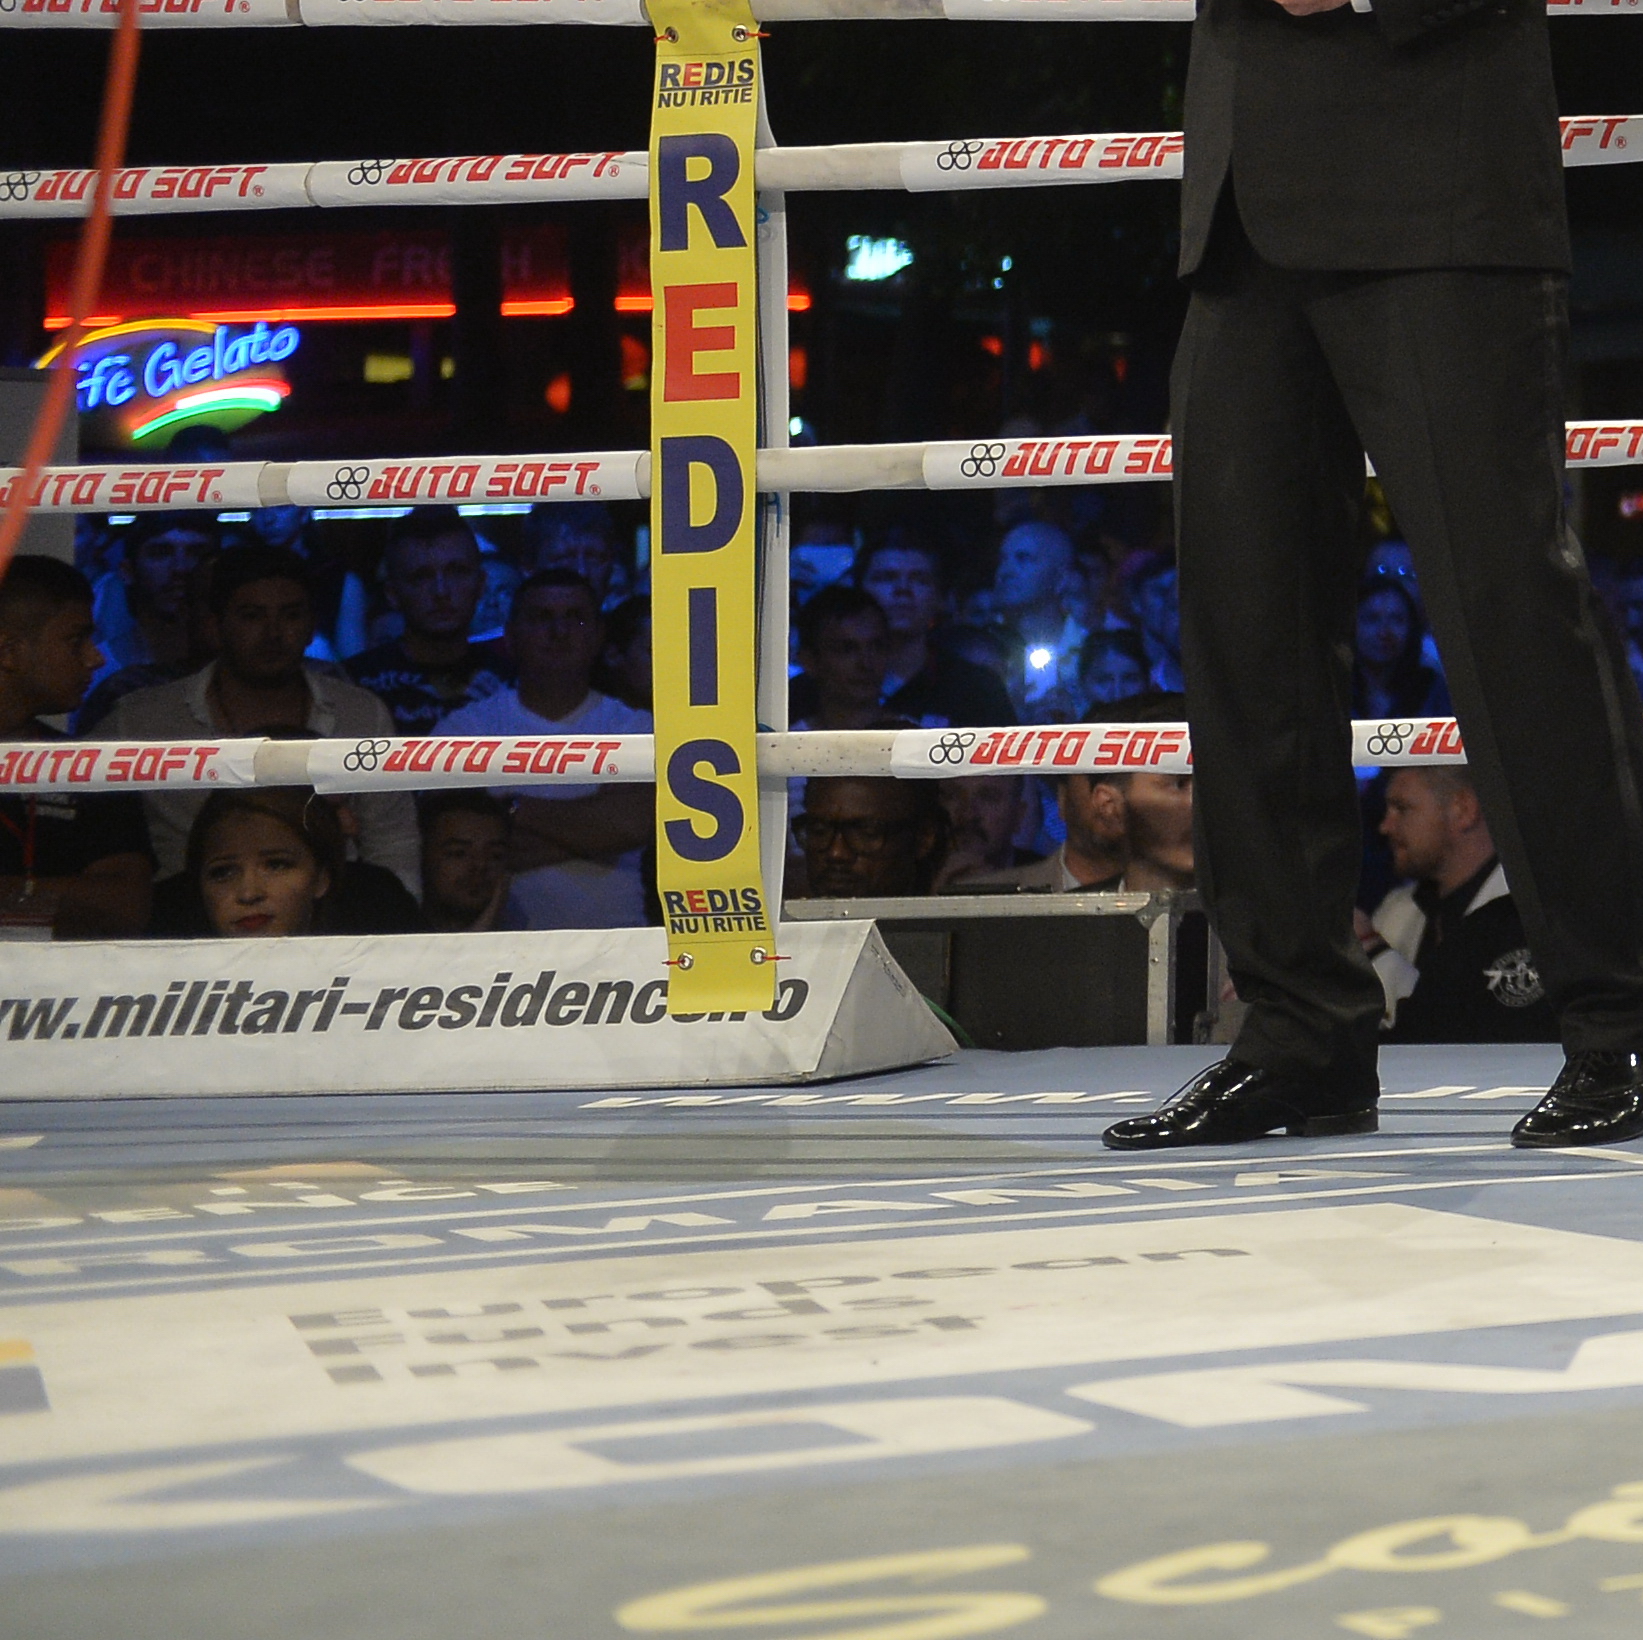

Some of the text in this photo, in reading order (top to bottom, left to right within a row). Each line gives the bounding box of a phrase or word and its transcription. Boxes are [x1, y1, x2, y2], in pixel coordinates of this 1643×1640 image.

[659, 58, 755, 88] REDIS
[657, 87, 753, 109] NUTRITIE
[1099, 136, 1184, 168] SOF
[144, 320, 300, 398] Gelato
[657, 132, 748, 862] REDIS
[1094, 731, 1193, 766] SOF
[663, 887, 762, 913] REDIS
[670, 915, 767, 934] NUTRITIE
[288, 1244, 1253, 1330] European
[304, 1292, 937, 1356] Funds
[323, 1311, 985, 1385] Invest
